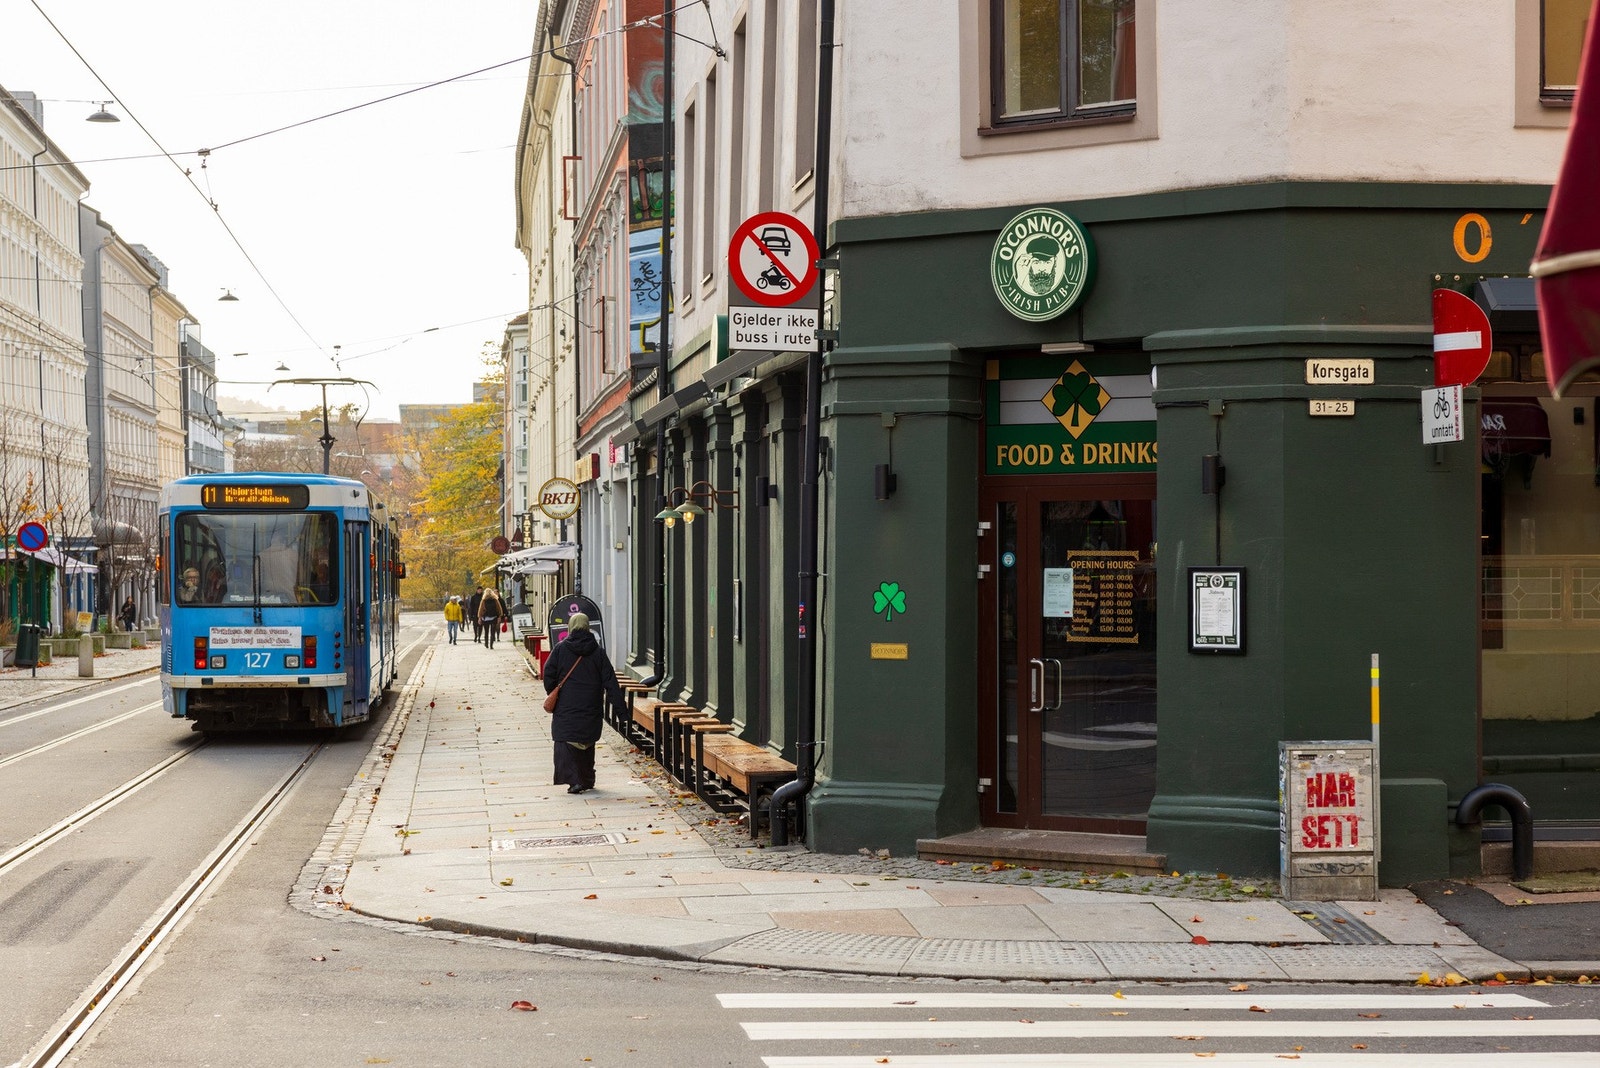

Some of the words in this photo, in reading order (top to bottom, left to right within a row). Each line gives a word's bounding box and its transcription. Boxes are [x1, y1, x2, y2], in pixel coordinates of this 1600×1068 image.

[1000, 215, 1080, 261] O'CONNOR'S
[1008, 288, 1040, 311] IRISH
[1045, 287, 1068, 309] PUB
[733, 312, 782, 328] Gjelder
[787, 315, 815, 328] ikke
[736, 330, 768, 343] buss
[774, 331, 778, 344] i
[784, 333, 811, 345] rute
[1312, 363, 1369, 382] Korsgata
[1431, 424, 1454, 438] unntatt
[996, 444, 1054, 466] FOOD
[1060, 443, 1076, 465] &
[203, 486, 216, 503] 11
[542, 492, 577, 505] BKH
[523, 514, 532, 548] TATTOO
[1070, 560, 1105, 569] OPENING
[1106, 560, 1136, 569] HOURS:
[244, 652, 271, 668] 127
[1307, 772, 1355, 807] HAR
[1302, 815, 1359, 848] SETT
